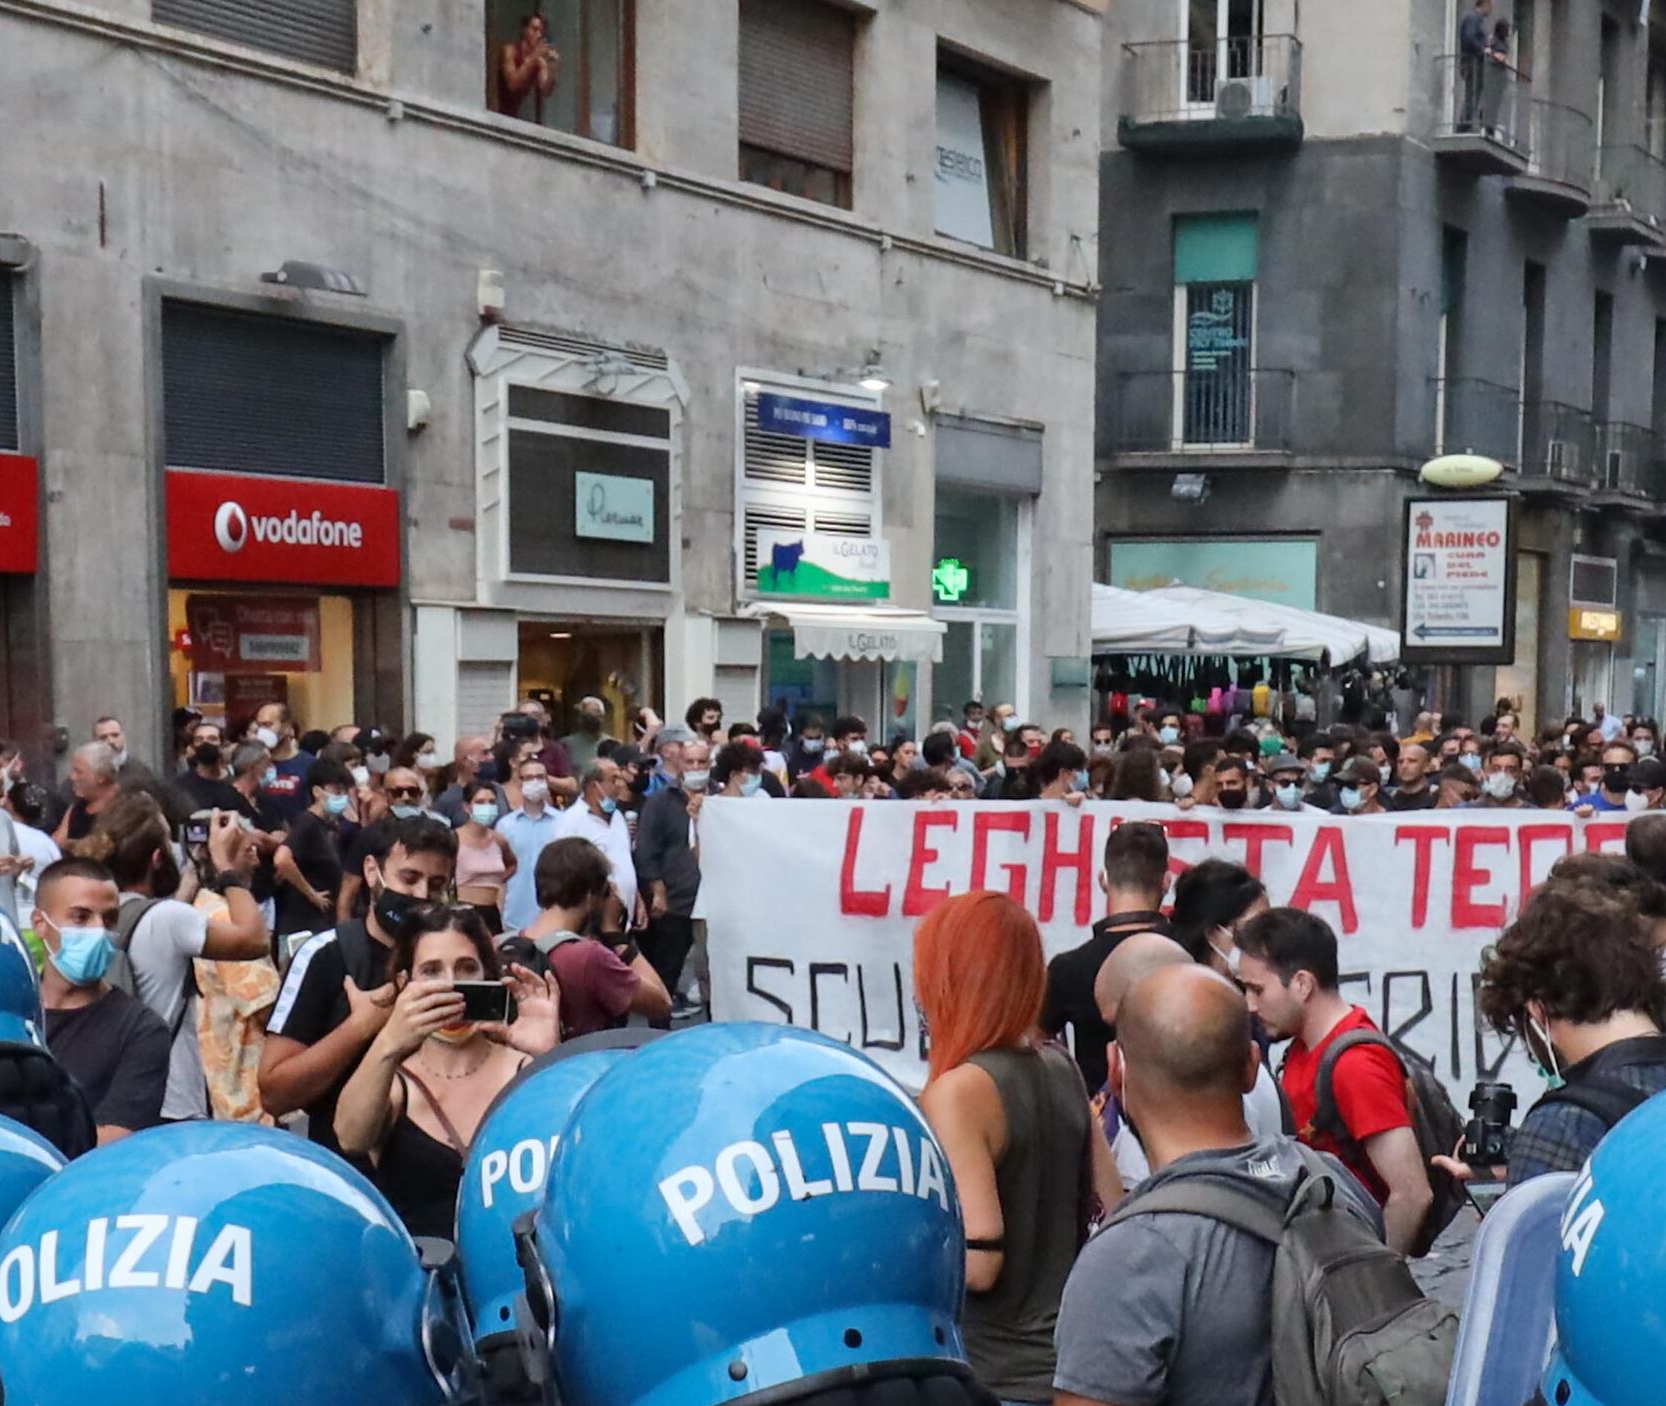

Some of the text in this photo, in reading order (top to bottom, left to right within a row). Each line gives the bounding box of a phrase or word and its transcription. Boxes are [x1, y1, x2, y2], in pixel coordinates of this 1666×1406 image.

[250, 509, 363, 548] vodafone
[1416, 531, 1500, 548] MARINEO
[856, 633, 897, 652] GELATO
[838, 805, 1359, 936] LEGHSTA
[658, 1121, 950, 1247] POLIZIA
